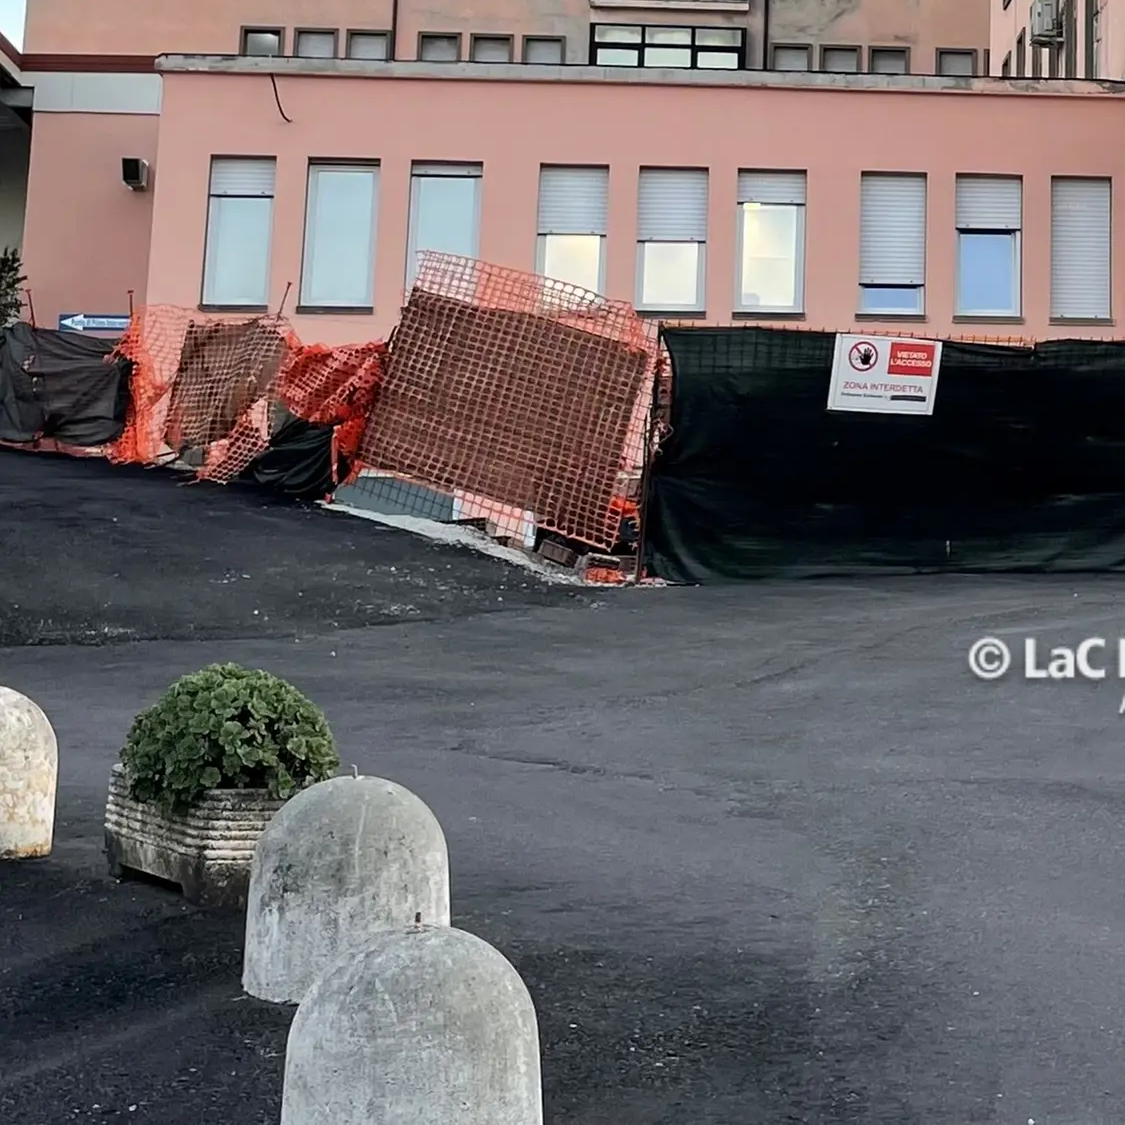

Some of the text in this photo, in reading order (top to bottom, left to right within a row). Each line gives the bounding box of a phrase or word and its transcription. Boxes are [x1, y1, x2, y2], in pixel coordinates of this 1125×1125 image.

[897, 351, 928, 360] VIETATO
[890, 359, 932, 368] L'ACCESSO
[843, 381, 924, 393] ZONA INTERDETTA
